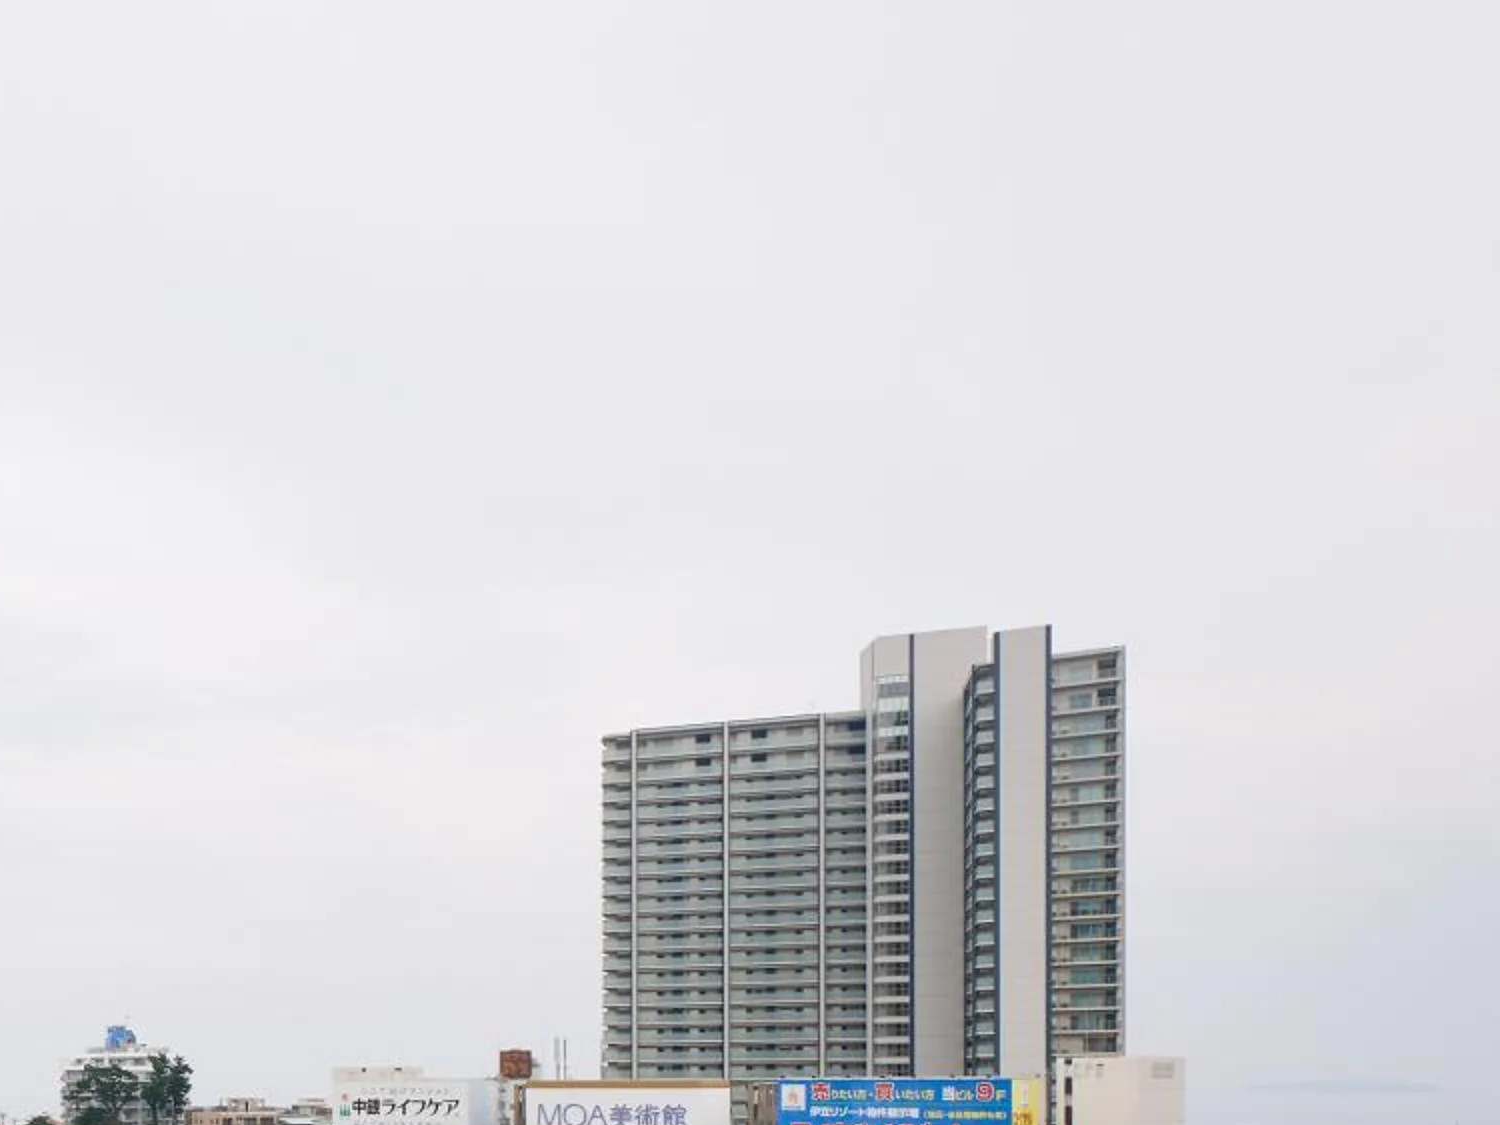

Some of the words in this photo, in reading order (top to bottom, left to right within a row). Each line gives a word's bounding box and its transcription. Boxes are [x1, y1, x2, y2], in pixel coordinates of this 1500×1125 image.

[351, 1097, 460, 1117] 中銀ライフケア
